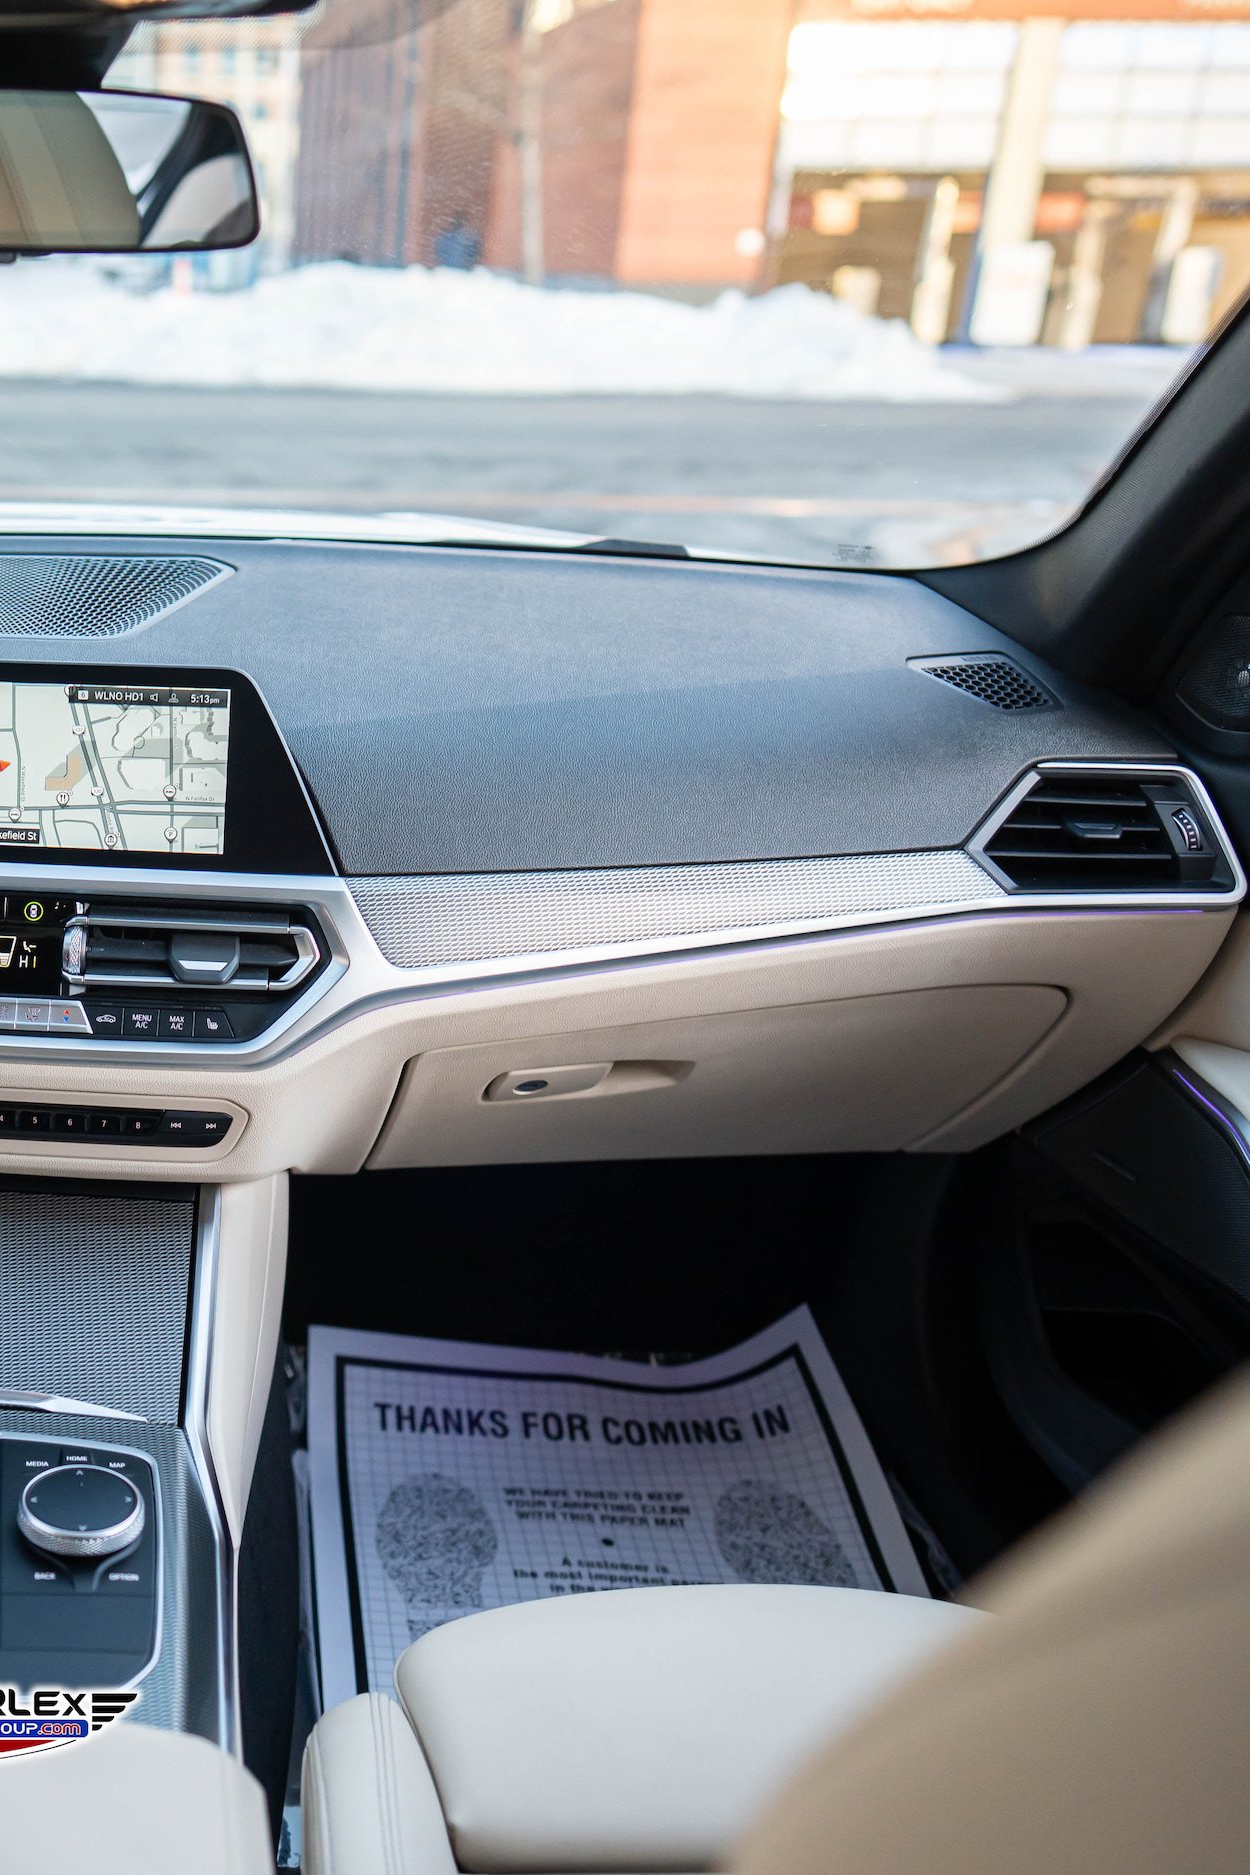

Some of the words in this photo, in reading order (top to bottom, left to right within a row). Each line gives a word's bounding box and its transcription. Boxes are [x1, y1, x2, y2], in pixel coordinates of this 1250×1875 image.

[94, 691, 123, 700] WLNO
[124, 693, 144, 701] HD1
[27, 831, 37, 840] St
[131, 1013, 153, 1022] MENU
[169, 1015, 185, 1023] MAX
[134, 1021, 148, 1029] A/C
[170, 1022, 184, 1031] A/C
[32, 1116, 38, 1124] 5
[67, 1118, 73, 1126] 6
[101, 1119, 107, 1128] 7
[135, 1121, 141, 1129] 8
[373, 1402, 510, 1438] THANKS
[521, 1411, 591, 1442] FOR
[601, 1415, 743, 1446] COMING
[751, 1403, 791, 1440] IN
